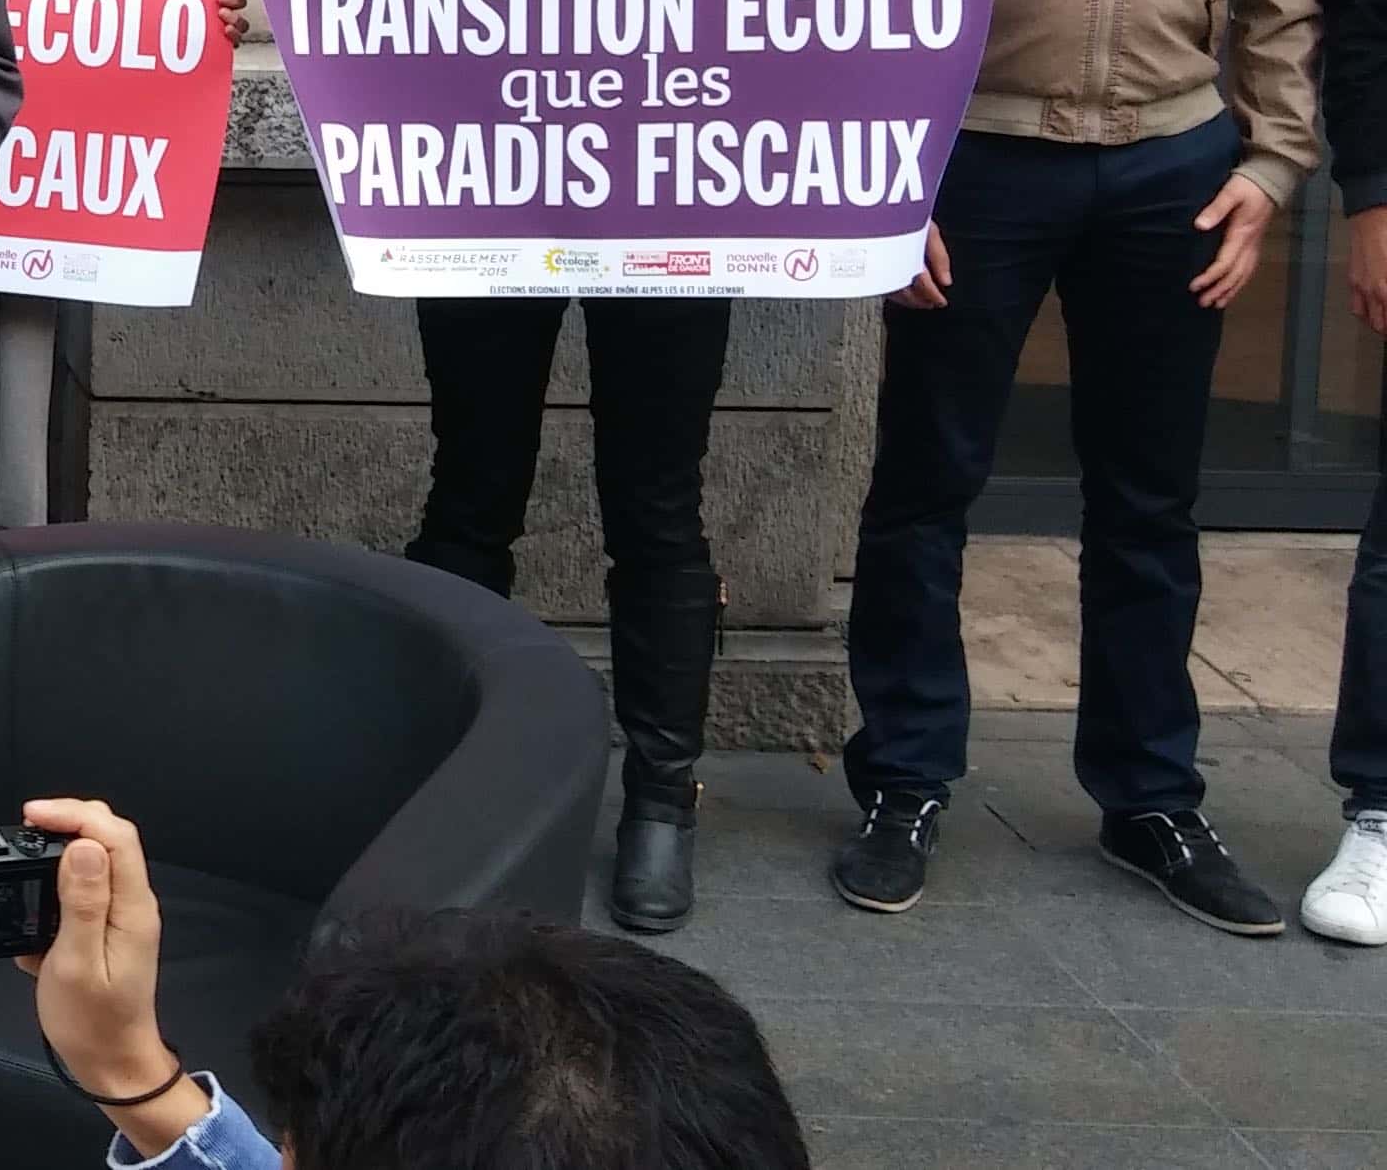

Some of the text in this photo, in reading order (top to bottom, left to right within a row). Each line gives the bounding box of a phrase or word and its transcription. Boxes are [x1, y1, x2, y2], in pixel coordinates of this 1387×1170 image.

[501, 54, 731, 123] que les
[321, 119, 930, 208] PARADIS FISCAUX
[398, 253, 519, 264] RASSEMBLEMENT
[554, 253, 600, 267] écologie
[668, 253, 710, 266] FRONT
[726, 251, 778, 263] nouvelle
[478, 266, 509, 278] 2015
[726, 262, 778, 273] DONNE
